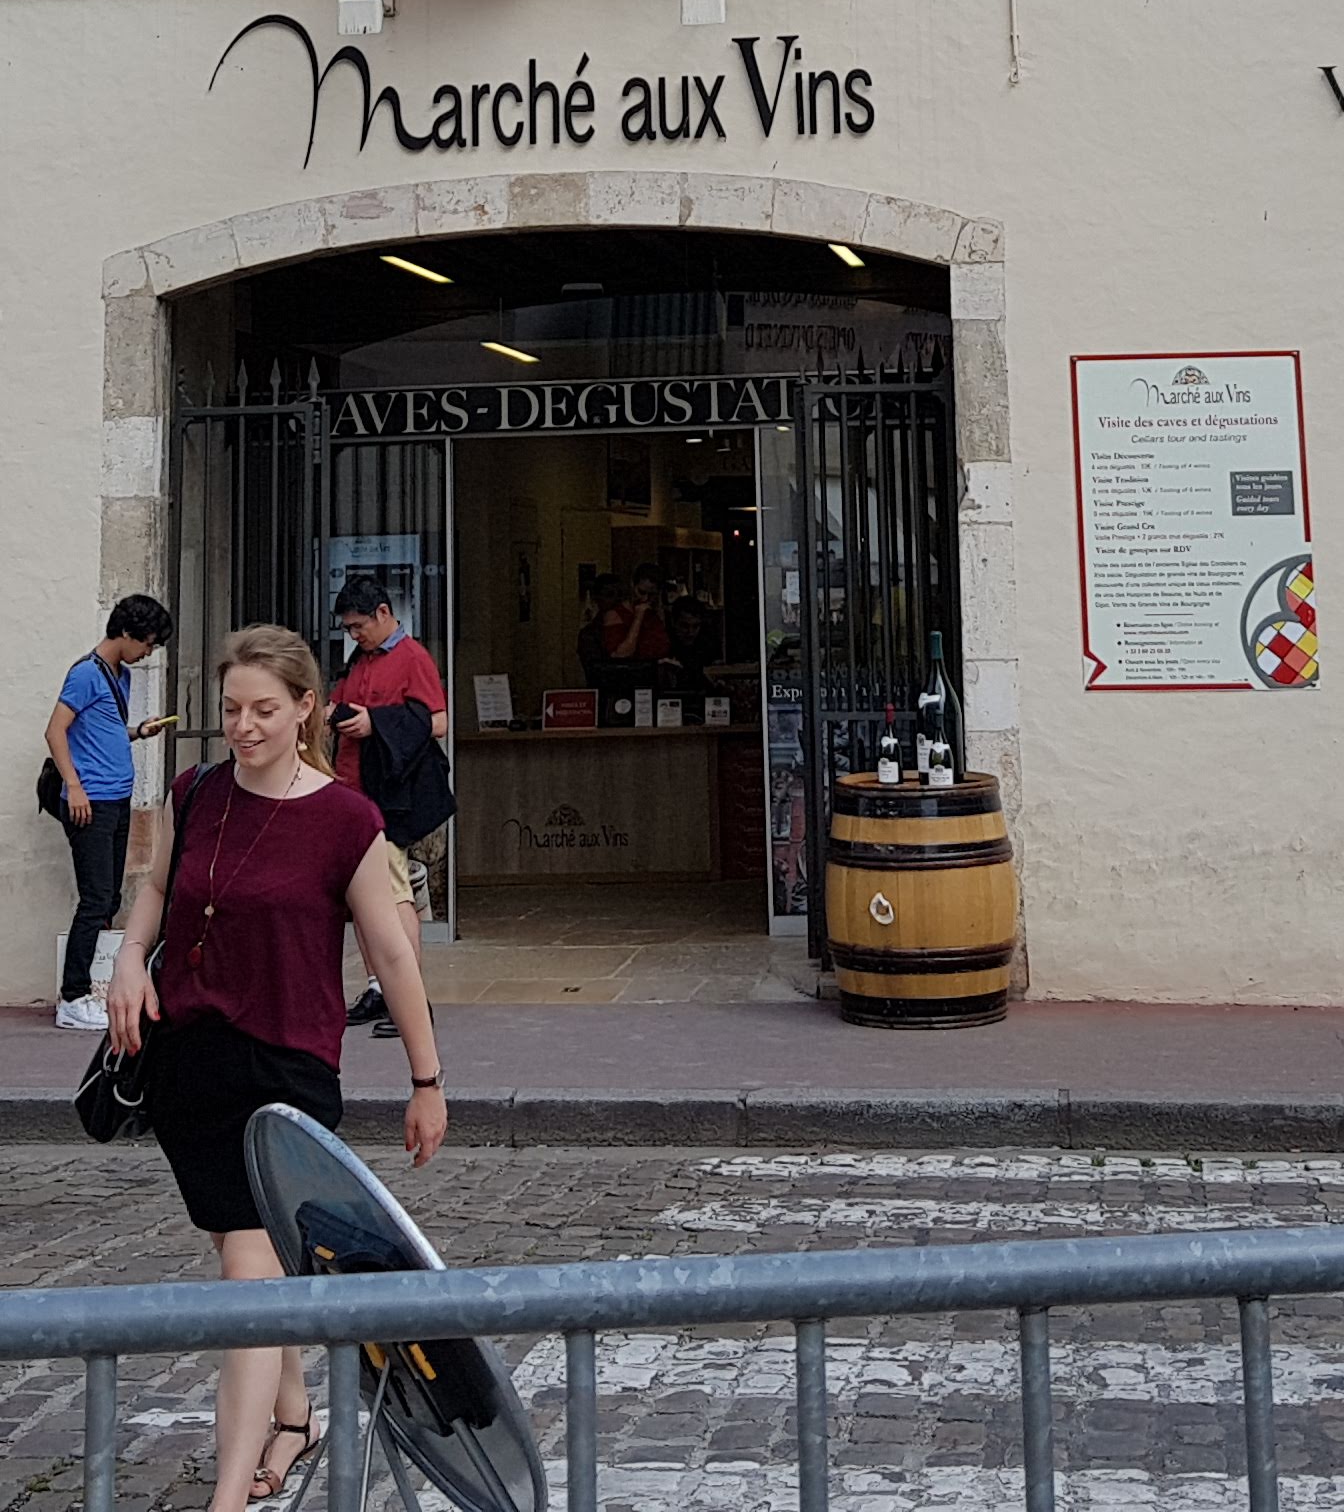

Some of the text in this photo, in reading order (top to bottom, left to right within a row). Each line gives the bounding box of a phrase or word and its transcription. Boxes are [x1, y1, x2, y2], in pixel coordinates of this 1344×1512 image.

[208, 14, 876, 171] Marché aux Vins
[1130, 378, 1251, 407] Marché aux Vins
[1098, 414, 1279, 430] Visite des caves et dégustations
[578, 832, 601, 848] aux
[601, 824, 629, 848] Vins
